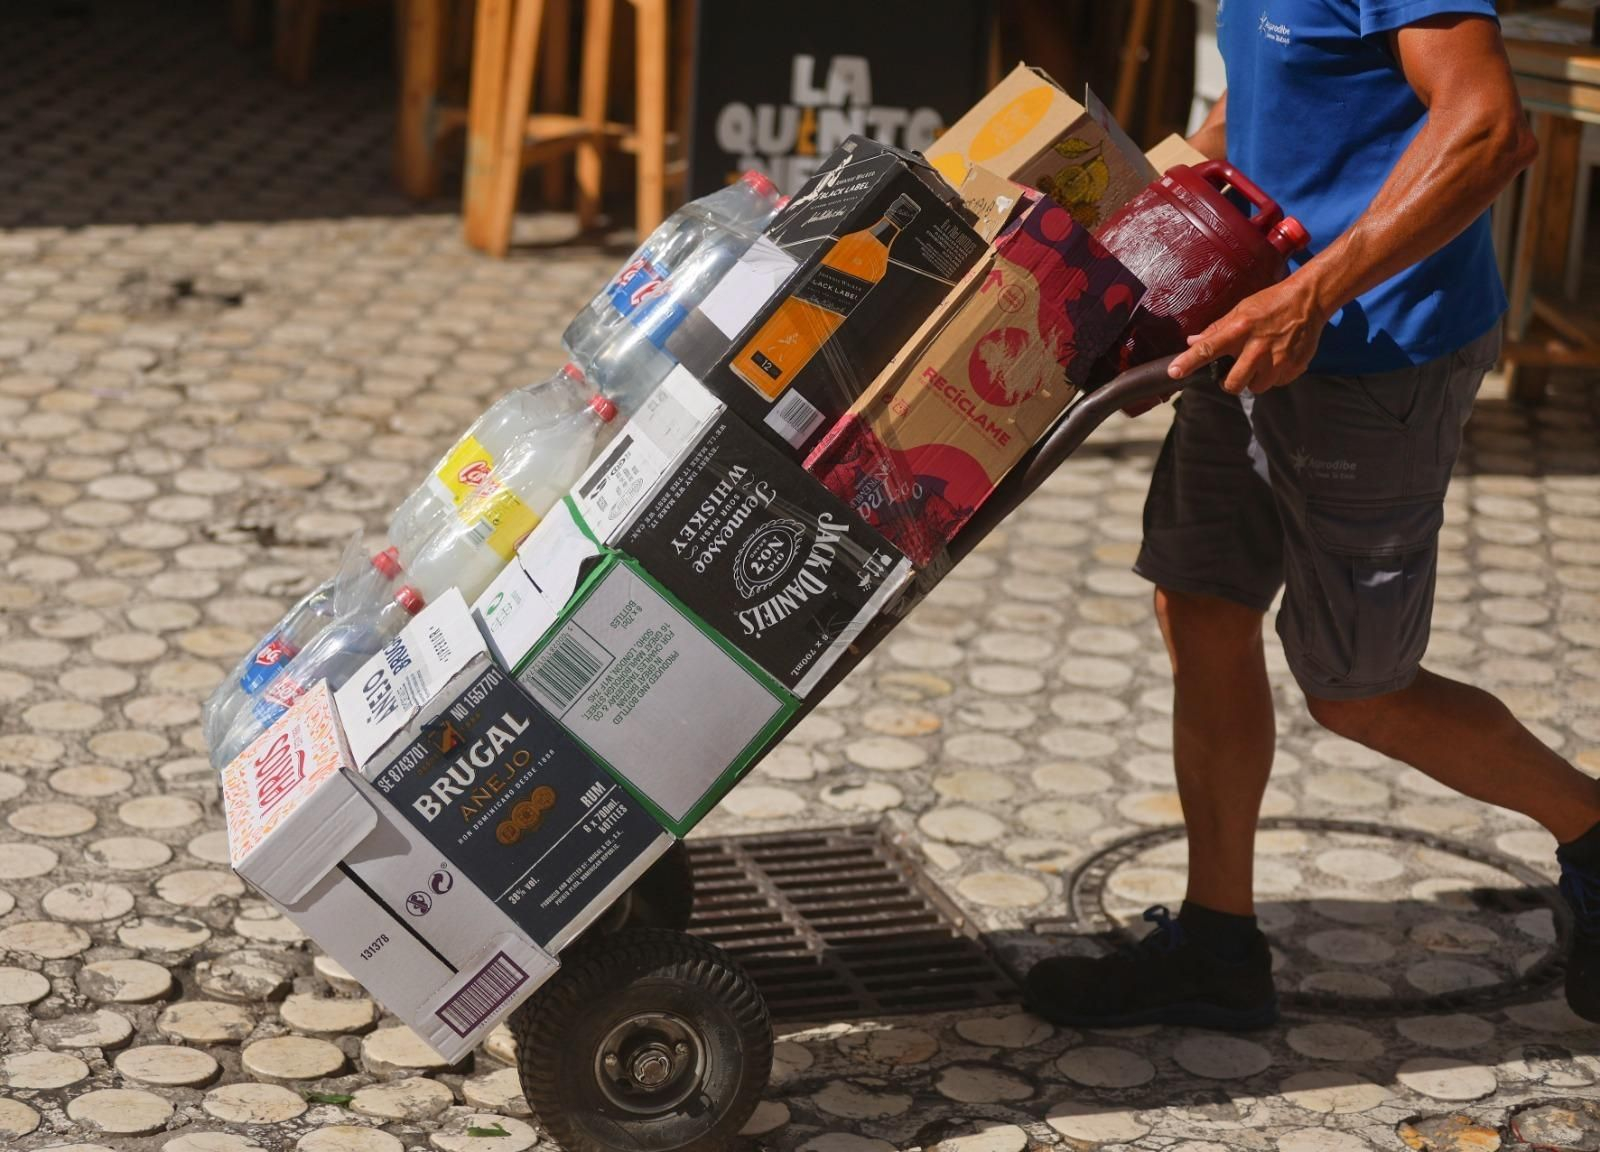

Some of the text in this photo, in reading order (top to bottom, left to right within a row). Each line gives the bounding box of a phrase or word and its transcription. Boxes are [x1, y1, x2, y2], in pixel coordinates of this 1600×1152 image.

[791, 54, 873, 106] LA
[843, 181, 869, 194] LABEL
[834, 287, 858, 300] LABEL
[762, 360, 772, 372] 12
[922, 366, 1012, 448] RECÍCLAME
[688, 445, 708, 467] MAKE
[669, 476, 683, 492] THE
[681, 466, 691, 476] IT
[683, 470, 697, 485] DAY
[653, 491, 671, 511] BEST
[673, 485, 685, 498] WE
[643, 511, 655, 523] WE
[656, 498, 675, 519] MAKE
[671, 464, 748, 555] WHISKEY
[699, 493, 741, 544] SOUR MASH
[695, 480, 777, 574] Tennessee
[749, 538, 768, 560] BRAND
[749, 536, 786, 575] No.7
[766, 552, 786, 572] Old
[738, 512, 850, 639] JACK DANIEL'S
[609, 599, 636, 629] BOTTLES
[620, 614, 635, 629] 70cl
[660, 621, 670, 632] 16
[643, 629, 662, 651] GREAT
[660, 630, 674, 645] FOR
[586, 627, 654, 703] SOHO, LONDON, W1F 7HS
[636, 642, 663, 672] CHARLES
[790, 647, 817, 677] 700mL
[602, 648, 645, 697] MARLBOROUGH
[615, 655, 662, 709] IN GREAT BRITAIN
[461, 667, 504, 709] 1557701
[607, 670, 639, 706] TANQUERAY
[612, 649, 679, 726] PRODUCED AND BOTTLED
[377, 775, 395, 793] SE
[386, 741, 429, 782] 8743701
[412, 712, 531, 823] BRUGAL
[459, 749, 531, 821] AÑEJO
[579, 780, 606, 807] RUM
[457, 829, 473, 844] RON
[472, 788, 516, 830] DOMINICANO
[514, 766, 538, 789] DESDE
[597, 803, 628, 833] BOTTLES
[582, 824, 591, 833] 6
[579, 859, 603, 881] DOMINICAN
[507, 886, 527, 905] 38%
[557, 881, 568, 891] AND
[360, 933, 390, 961] 131378
